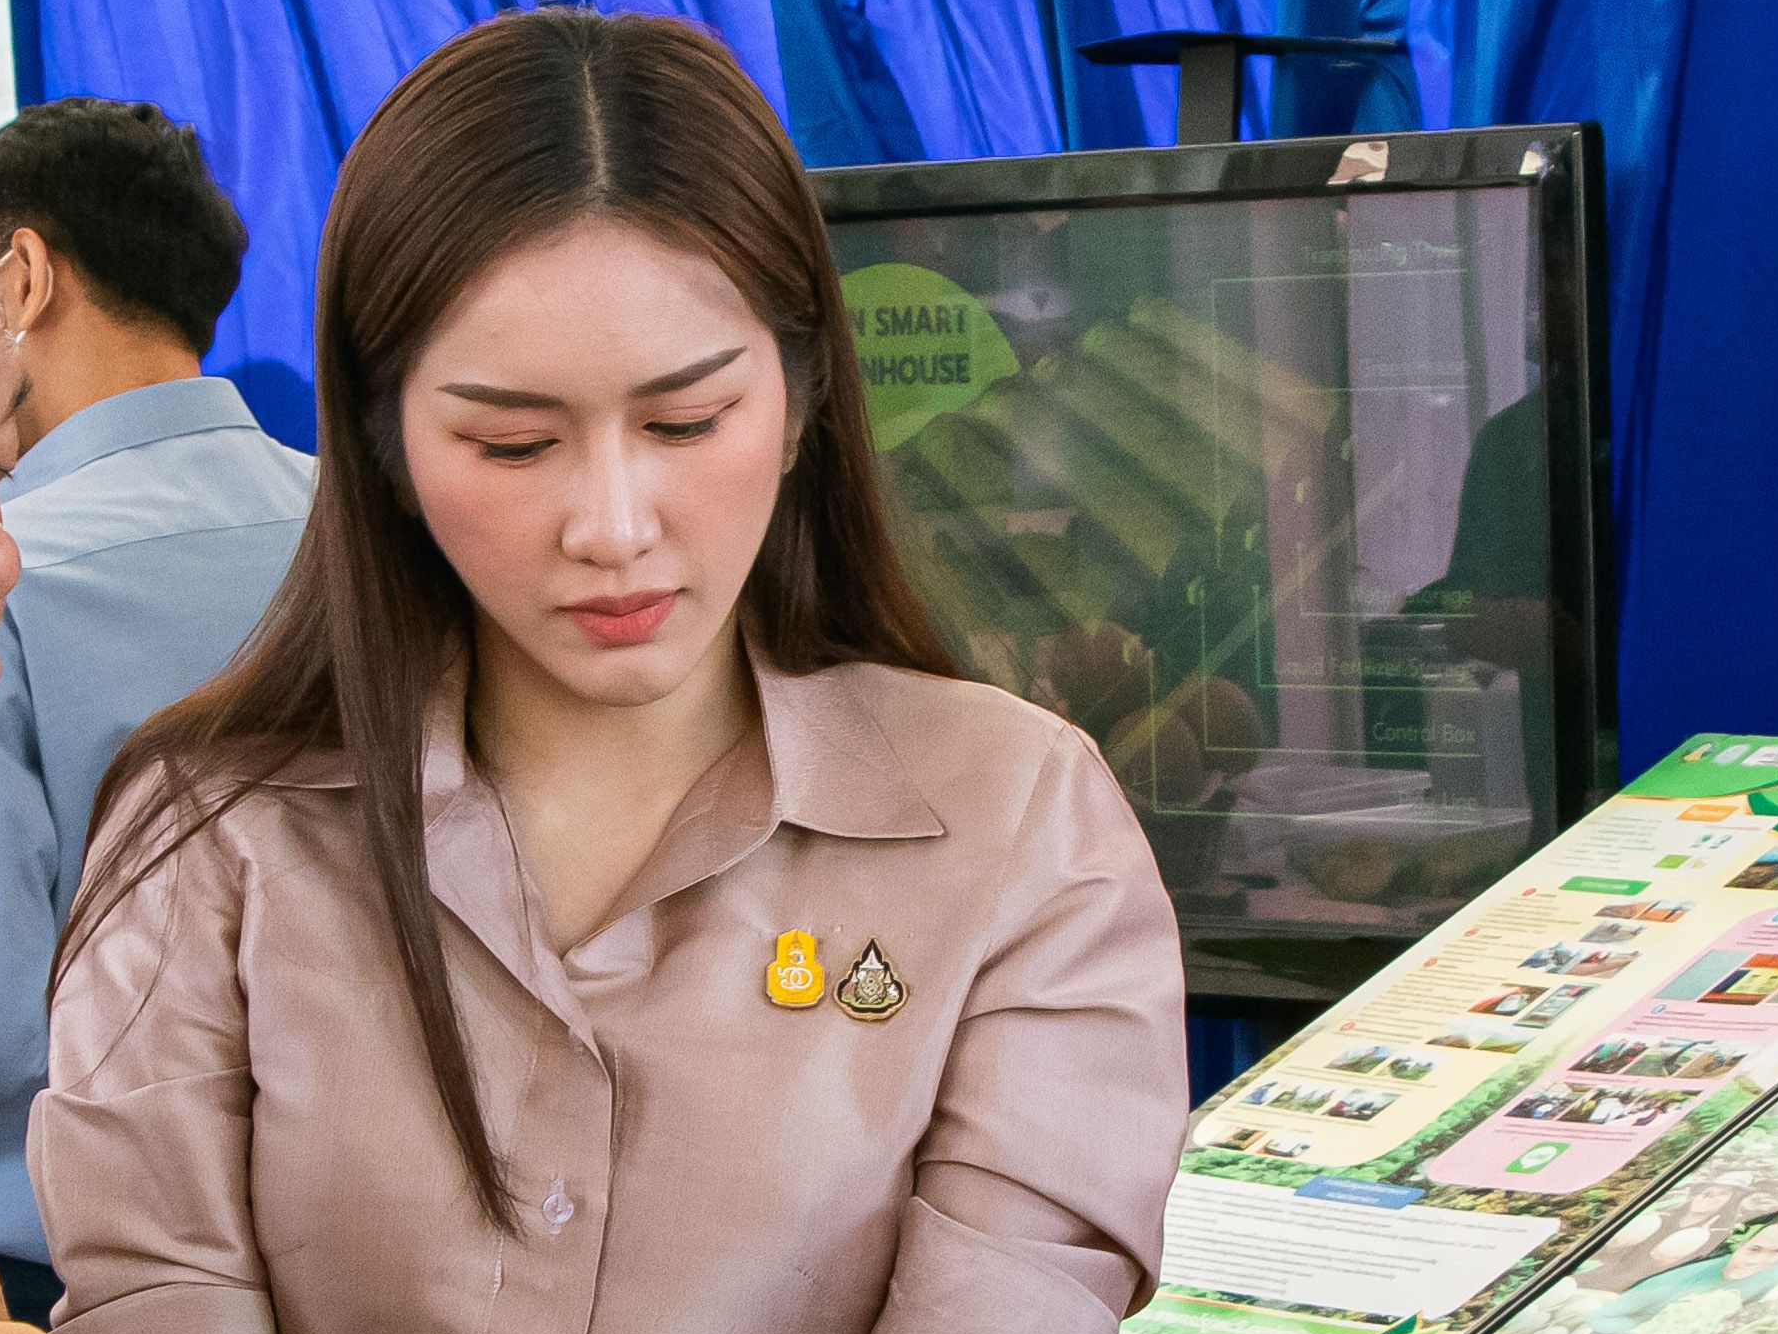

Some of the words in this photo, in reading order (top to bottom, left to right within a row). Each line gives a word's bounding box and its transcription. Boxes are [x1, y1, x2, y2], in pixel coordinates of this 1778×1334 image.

[875, 304, 969, 337] SMART
[1372, 720, 1437, 742] Control
[1442, 721, 1477, 744] Box
